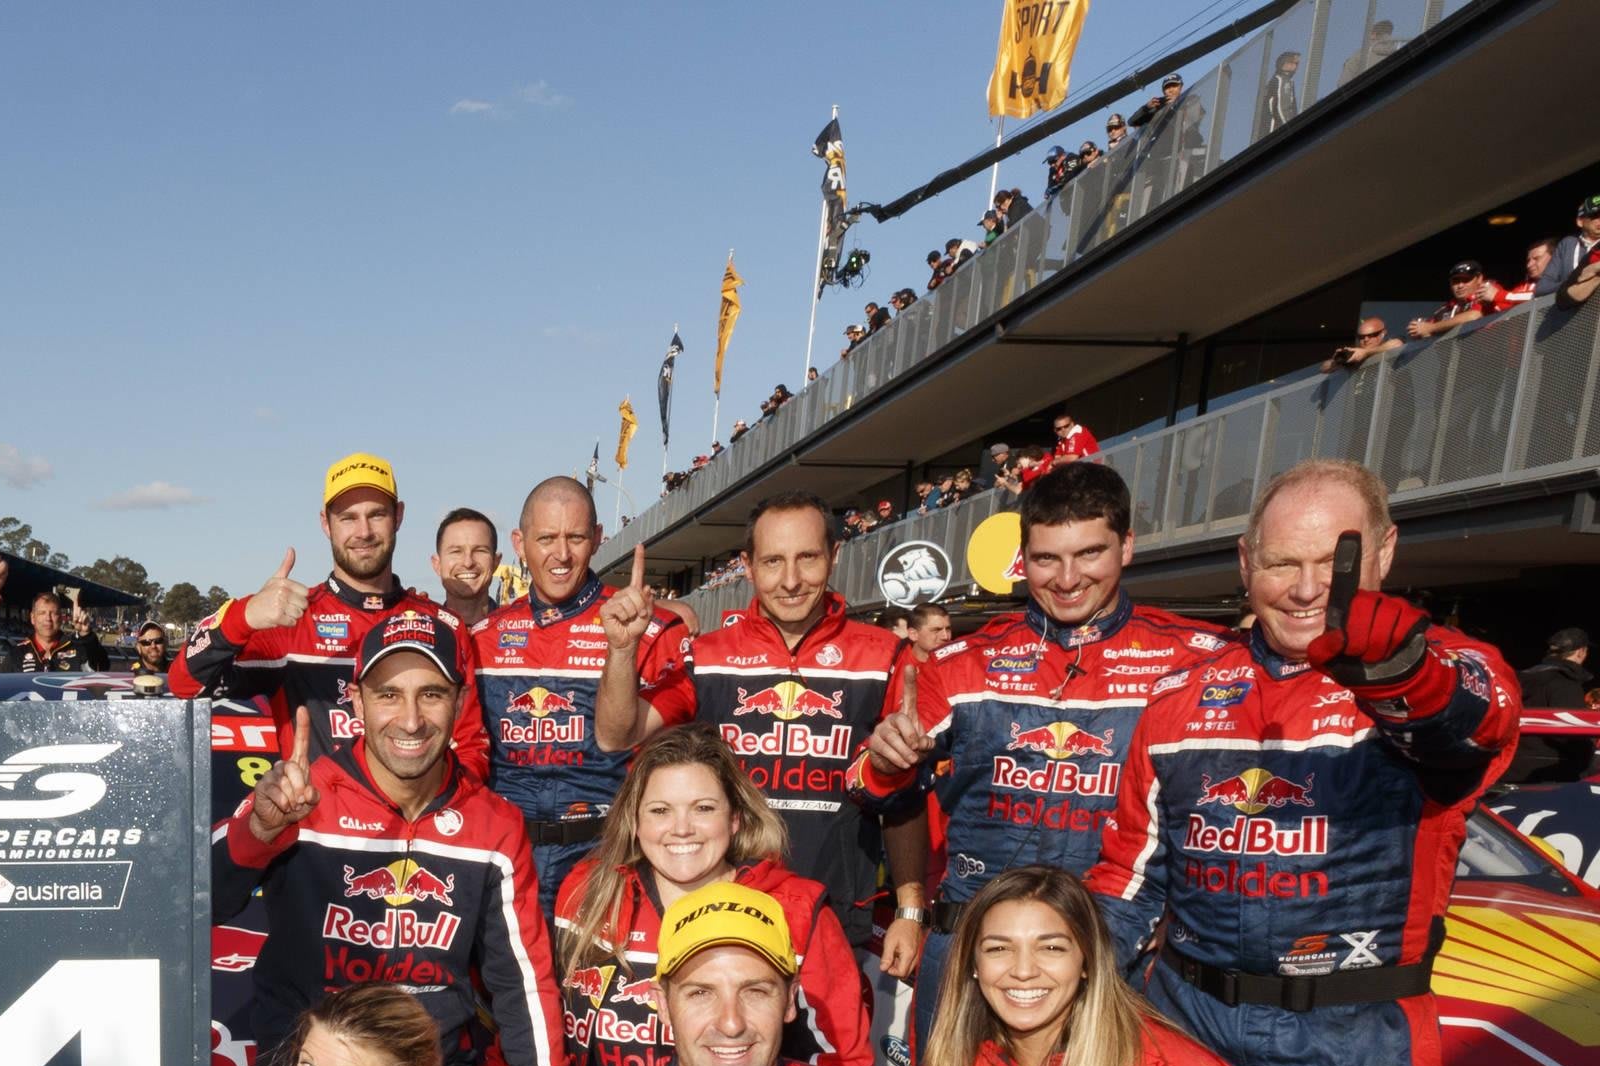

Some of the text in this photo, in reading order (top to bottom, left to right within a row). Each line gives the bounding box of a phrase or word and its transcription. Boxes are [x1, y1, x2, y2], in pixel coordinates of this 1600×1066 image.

[1015, 1, 1070, 45] SPORT
[331, 462, 389, 482] DUNLOP
[319, 613, 351, 622] CALTEX
[507, 619, 535, 630] CALTEX
[568, 656, 605, 667] IVECO
[726, 654, 768, 665] CALTEX
[1103, 648, 1174, 658] GEARWRENCH
[1217, 666, 1256, 681] CALTE
[1109, 683, 1148, 694] IVEC
[328, 709, 364, 739] Re
[500, 715, 584, 743] Red Bull
[1204, 720, 1237, 731] STEEL
[719, 721, 852, 760] Red Bull
[739, 758, 848, 791] olden
[992, 756, 1121, 796] Red Bull
[767, 799, 798, 811] ACING
[1184, 814, 1328, 855] Red Bull
[15, 882, 102, 900] australia
[1184, 858, 1329, 899] Holden
[323, 903, 461, 951] Red Bull
[672, 901, 775, 935] DUNLOP
[324, 945, 455, 984] Holden
[596, 1007, 658, 1045] Red
